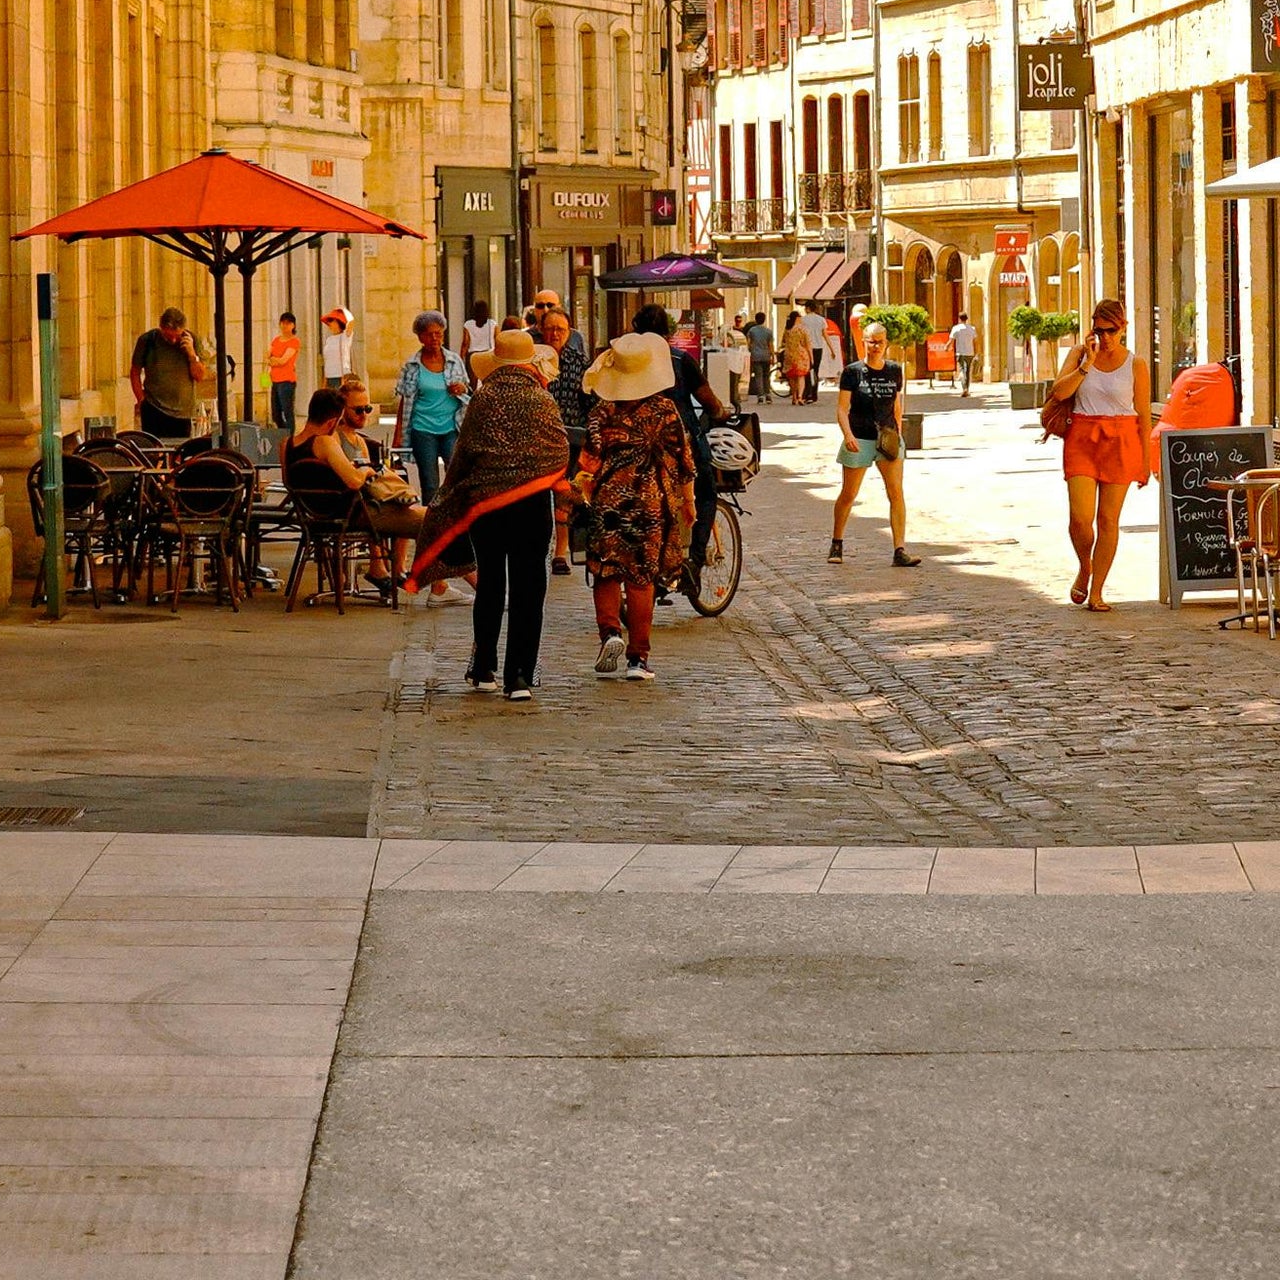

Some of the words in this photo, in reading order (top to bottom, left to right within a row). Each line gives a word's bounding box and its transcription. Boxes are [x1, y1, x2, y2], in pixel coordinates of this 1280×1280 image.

[1026, 52, 1063, 98] joli
[1034, 86, 1076, 102] caprice
[463, 191, 494, 211] AXEL
[553, 191, 610, 208] DUFOUX
[1228, 448, 1251, 464] de
